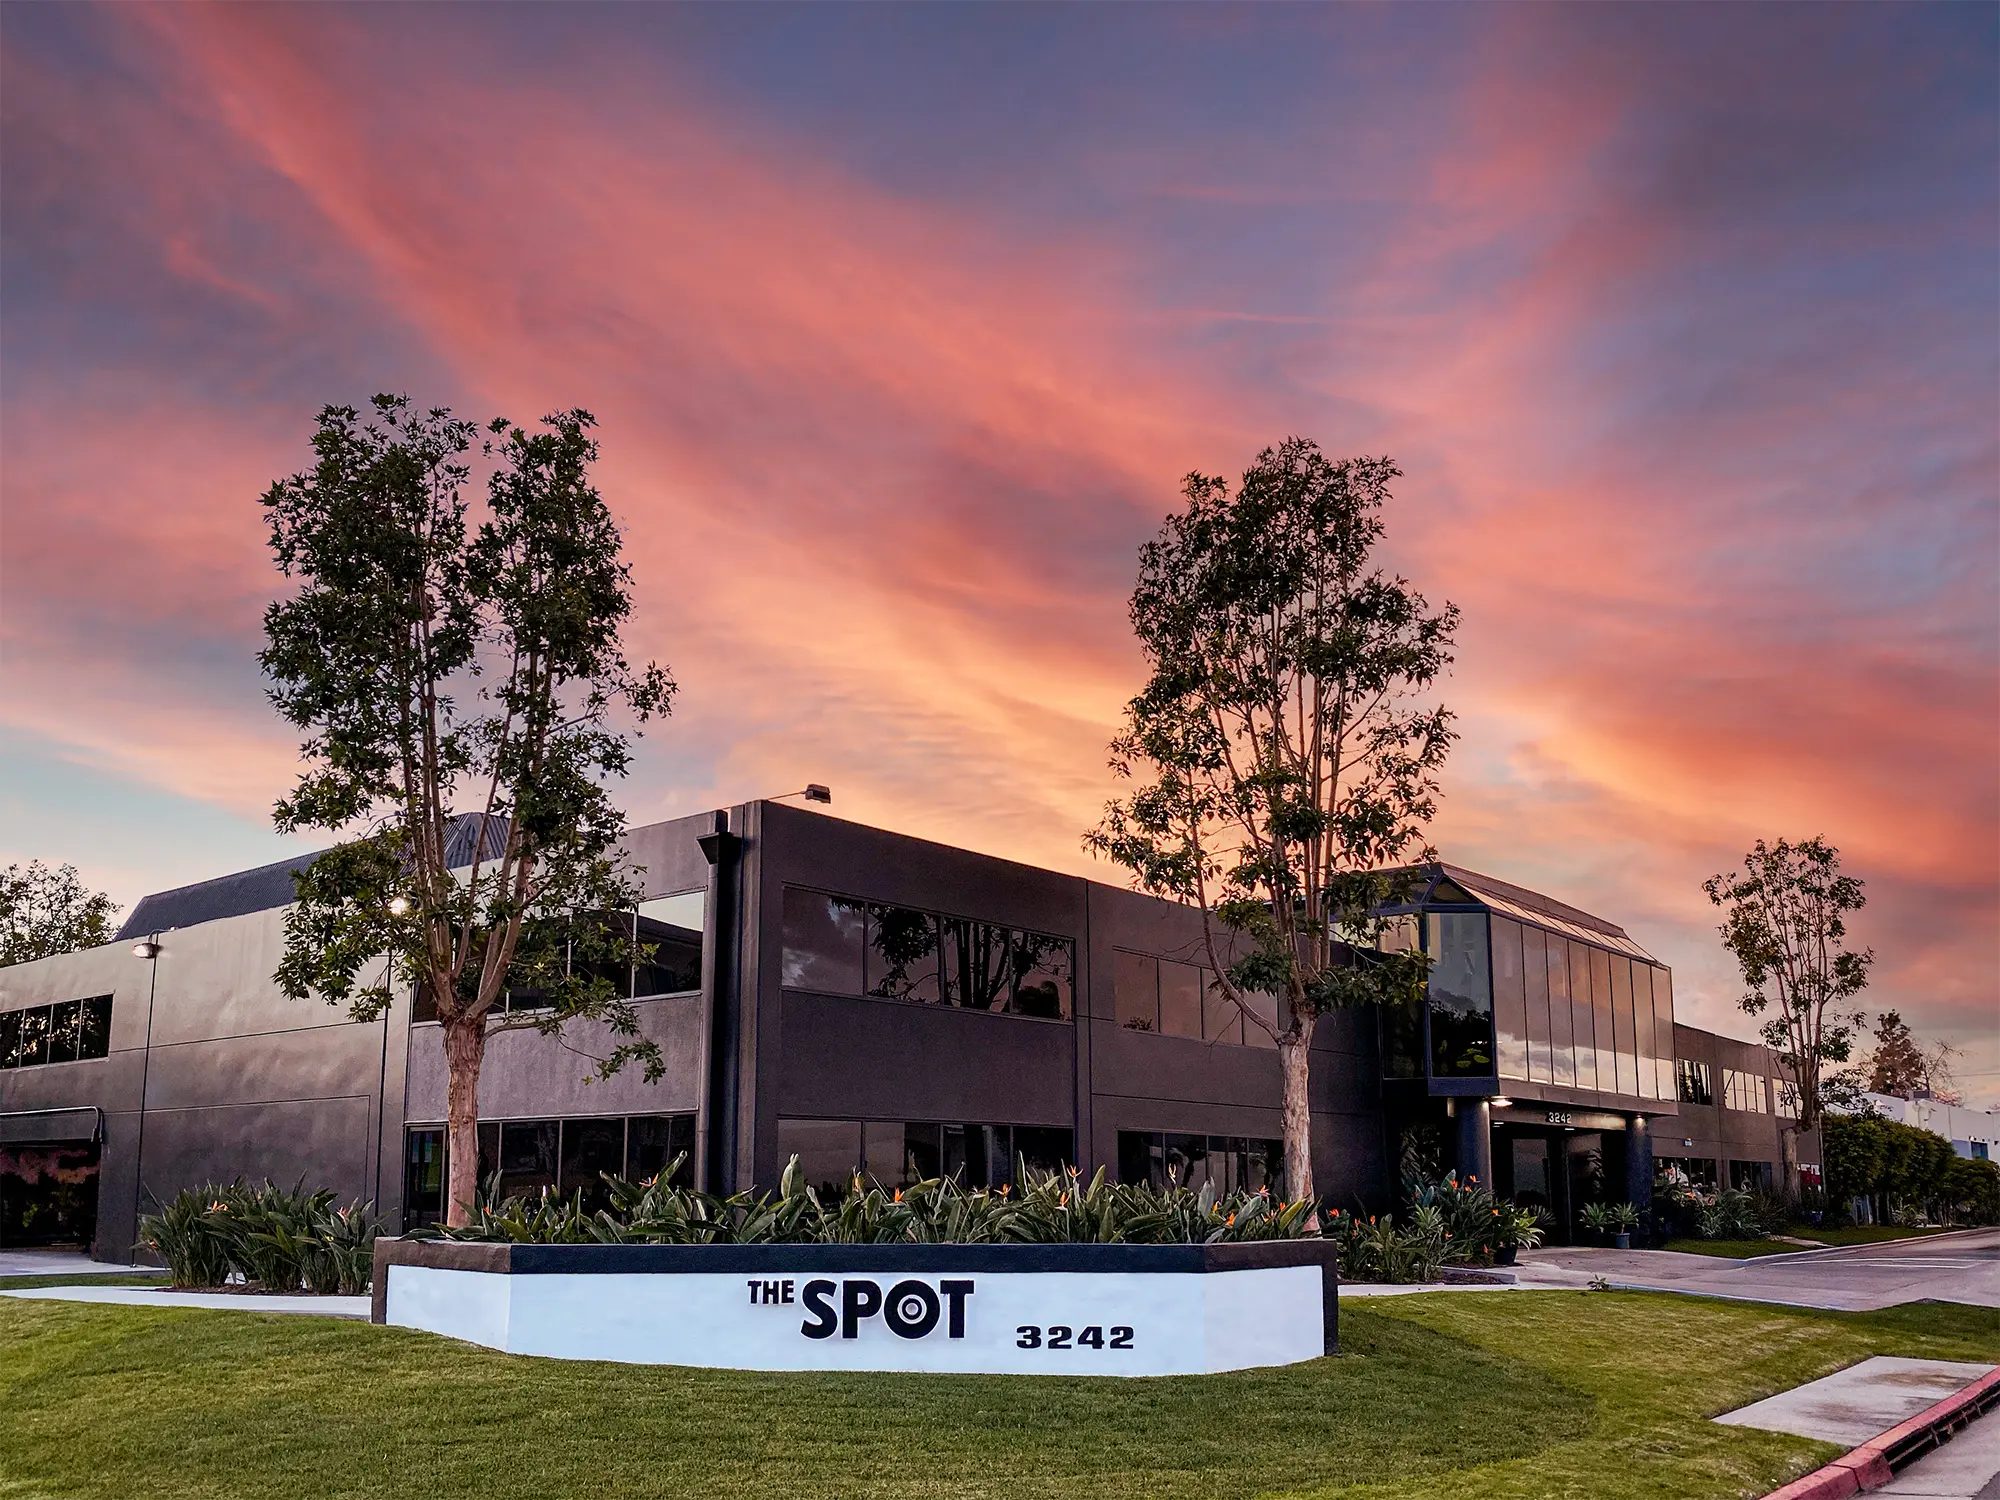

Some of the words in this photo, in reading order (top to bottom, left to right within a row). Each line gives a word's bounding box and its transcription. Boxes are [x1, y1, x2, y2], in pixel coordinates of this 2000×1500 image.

[1549, 1112, 1572, 1123] 3242
[747, 1280, 795, 1304] THE
[801, 1280, 974, 1339] SPOT
[1016, 1326, 1134, 1349] 3242
